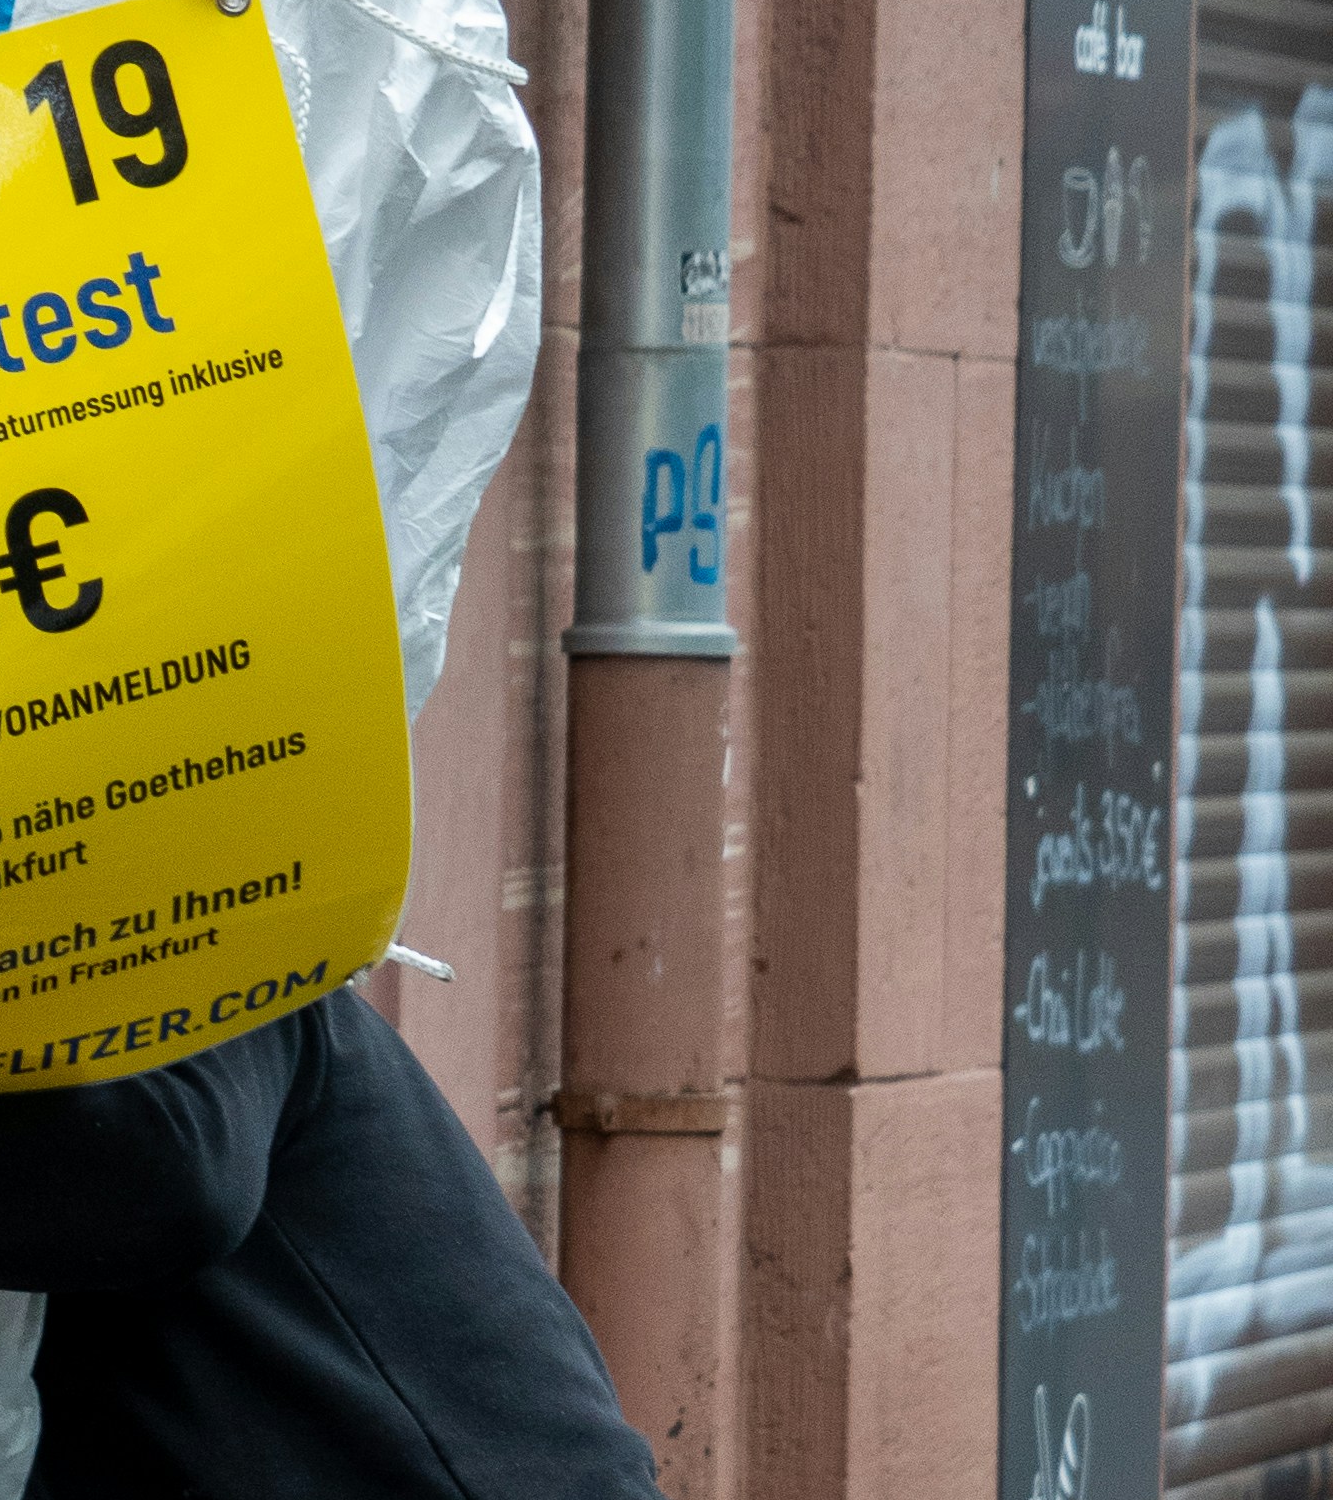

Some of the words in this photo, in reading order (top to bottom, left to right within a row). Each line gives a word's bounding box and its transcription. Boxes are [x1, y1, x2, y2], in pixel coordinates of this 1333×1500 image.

[1114, 3, 1146, 80] bar
[23, 39, 189, 206] 19
[170, 349, 283, 396] inklusive
[13, 796, 95, 839] nähe
[105, 732, 306, 811] Goethehaus
[109, 909, 156, 942] zu
[172, 861, 302, 924] Ihnen!
[31, 975, 58, 995] in
[69, 927, 218, 985] Frankfurt
